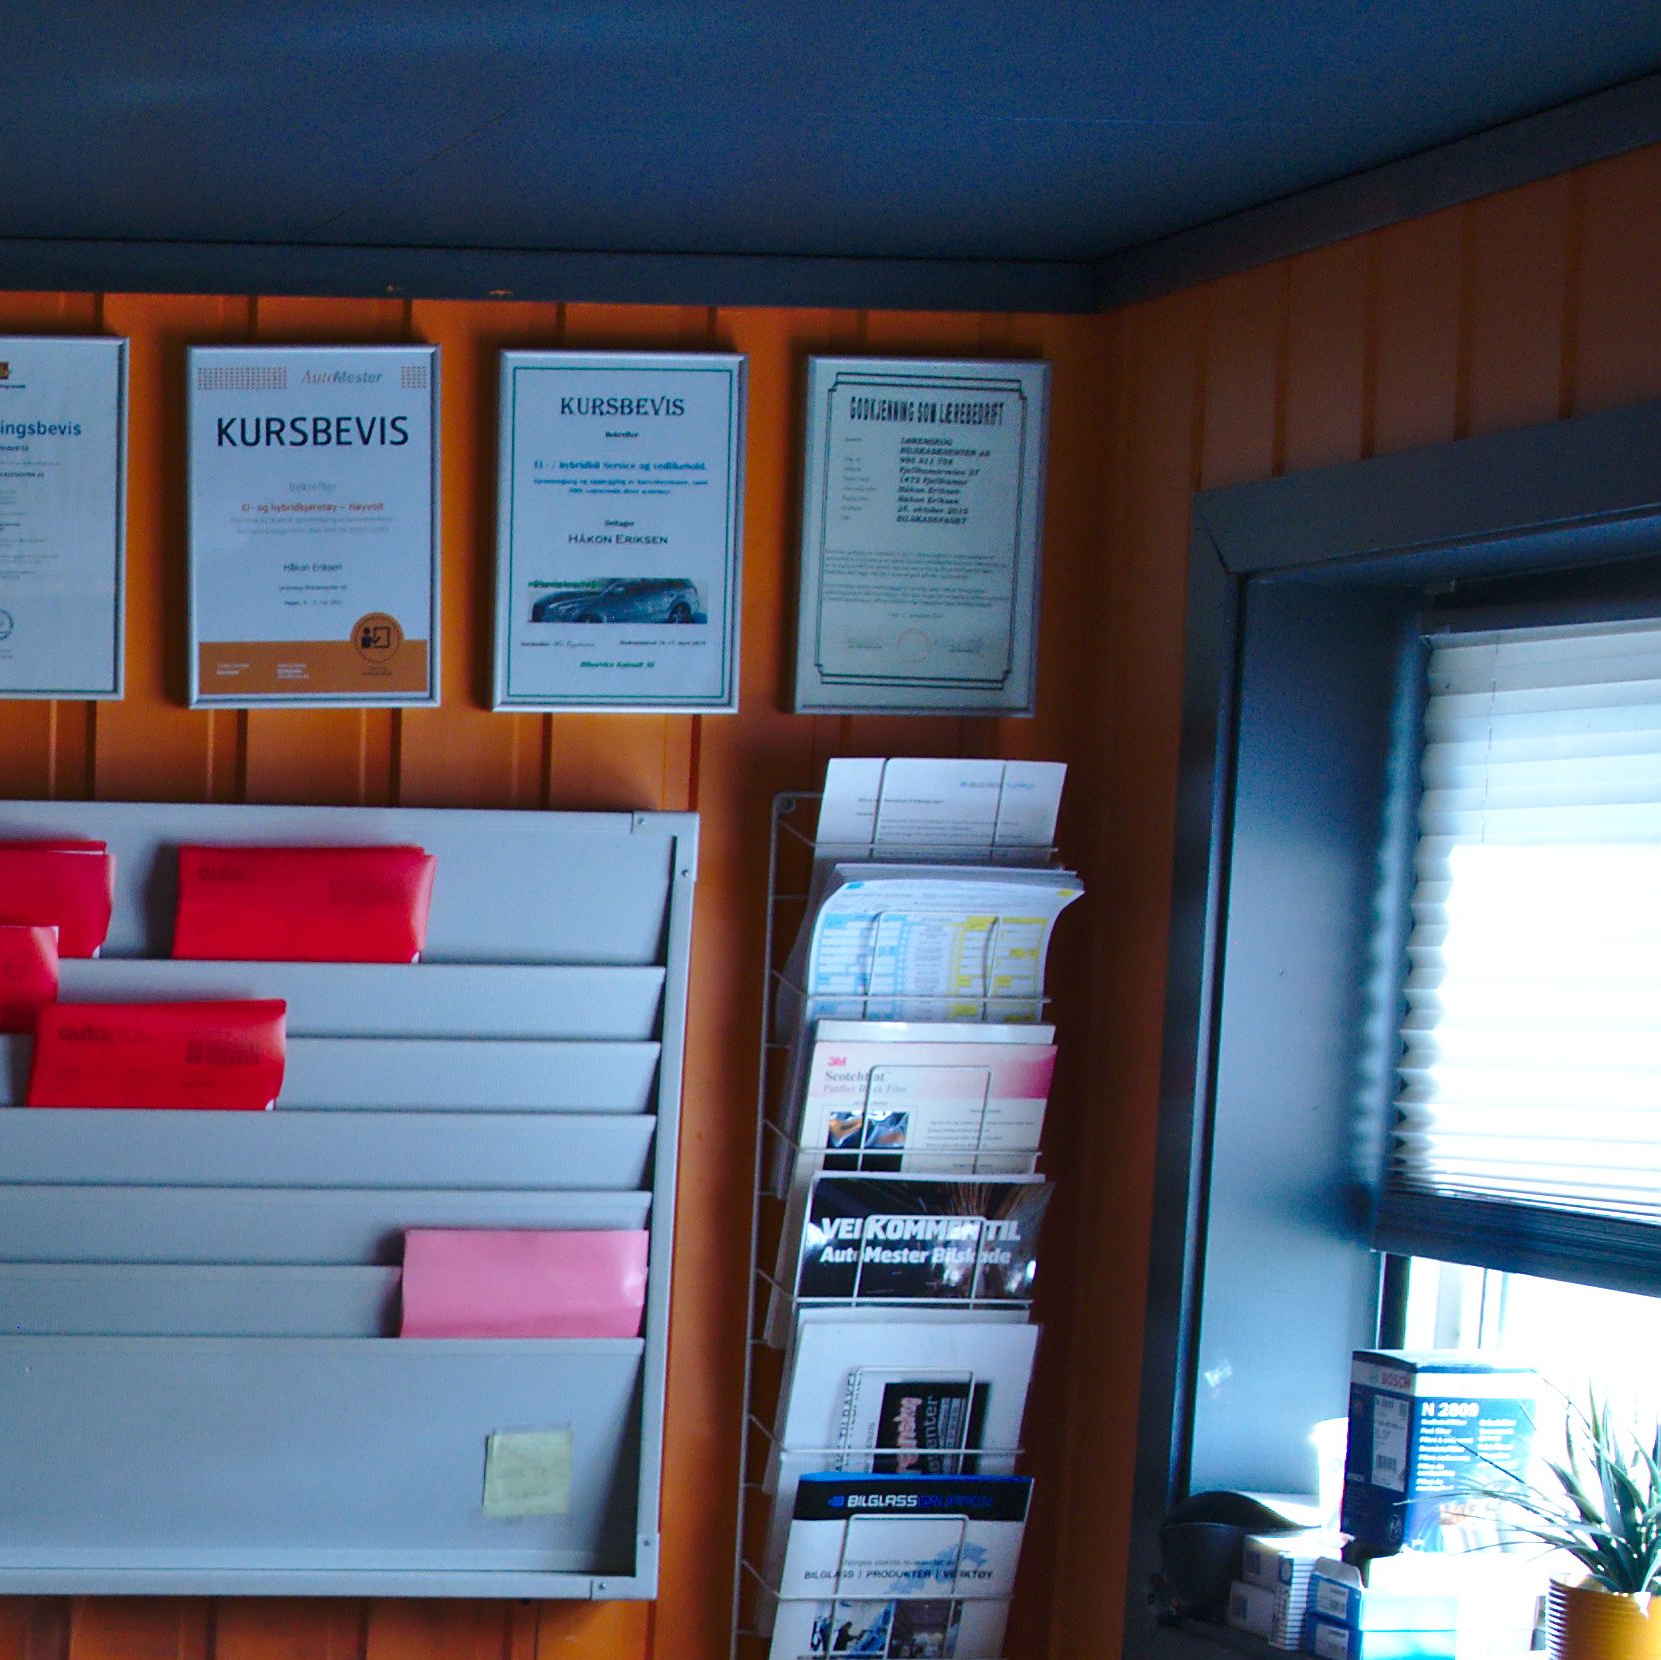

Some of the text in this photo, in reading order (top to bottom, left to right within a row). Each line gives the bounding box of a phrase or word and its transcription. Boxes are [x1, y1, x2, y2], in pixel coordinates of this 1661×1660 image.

[301, 370, 383, 386] AutoMester
[560, 396, 685, 416] KURSBEVIS
[850, 396, 1004, 426] GODKJENNING SOM LÆREBEDRIFT
[217, 416, 408, 447] KURSBEVIS
[569, 533, 668, 545] HÅKON ERIKSEN
[827, 1055, 846, 1066] 3M
[986, 1220, 1021, 1241] TIL
[1381, 1372, 1411, 1389] BOSCH
[1422, 1403, 1434, 1416] N
[866, 1570, 931, 1579] PRODUKTER
